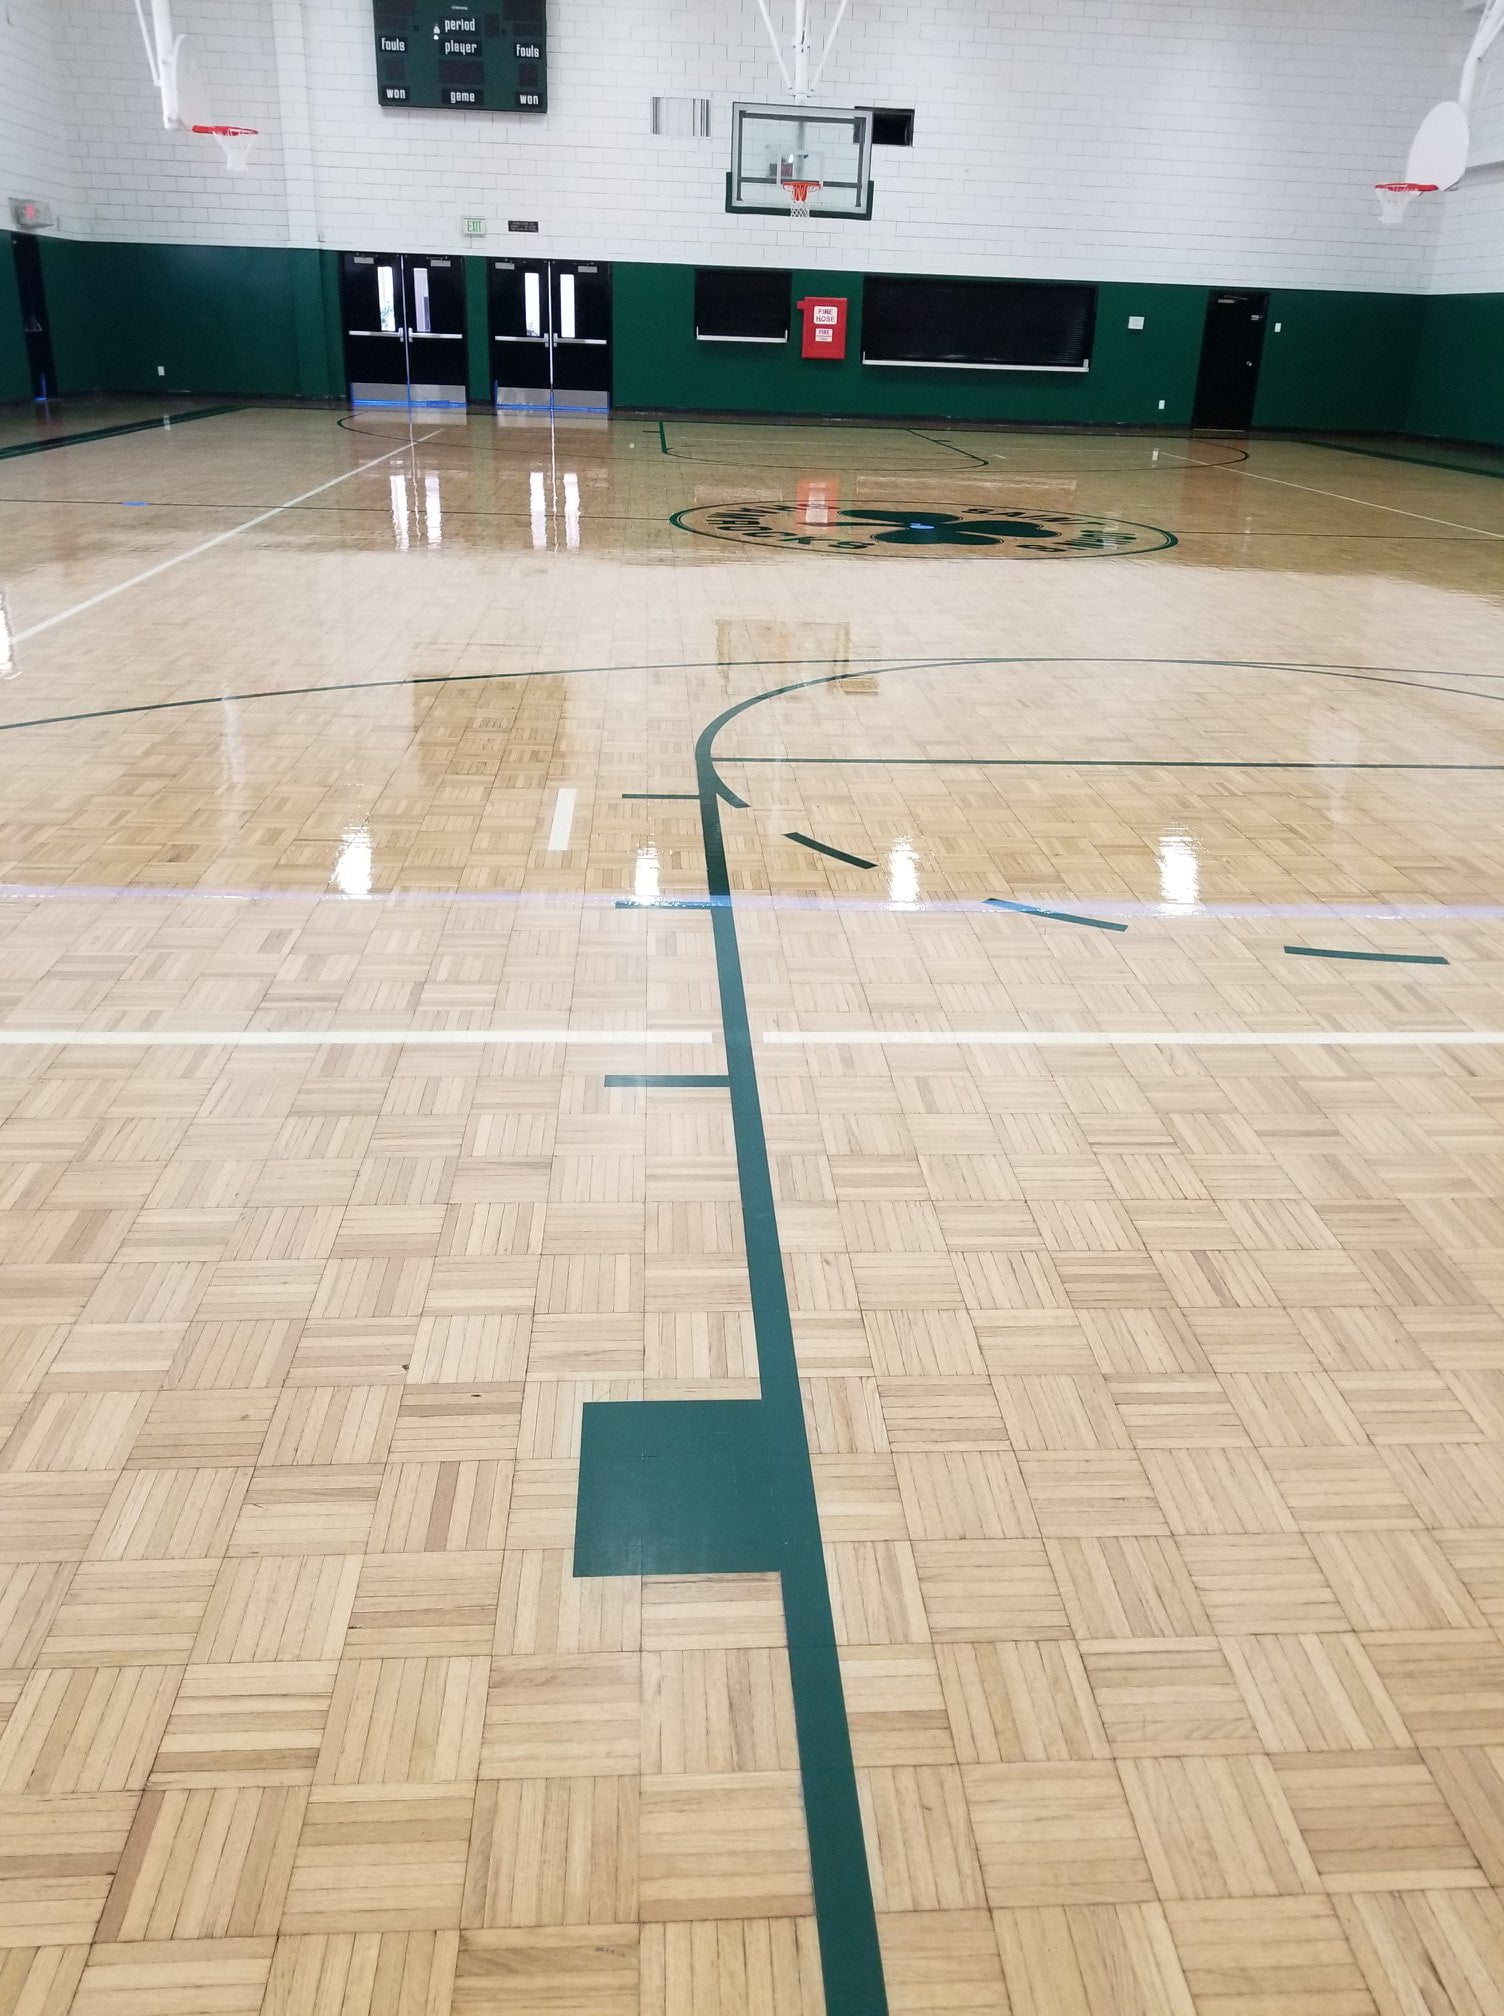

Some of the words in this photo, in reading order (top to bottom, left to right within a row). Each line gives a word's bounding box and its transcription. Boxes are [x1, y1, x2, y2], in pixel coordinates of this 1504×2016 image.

[445, 18, 476, 33] period
[445, 40, 477, 55] player
[386, 88, 406, 99] won
[450, 91, 475, 103] game
[519, 94, 539, 105] won
[467, 220, 482, 232] EXIT
[815, 315, 835, 323] HOSE
